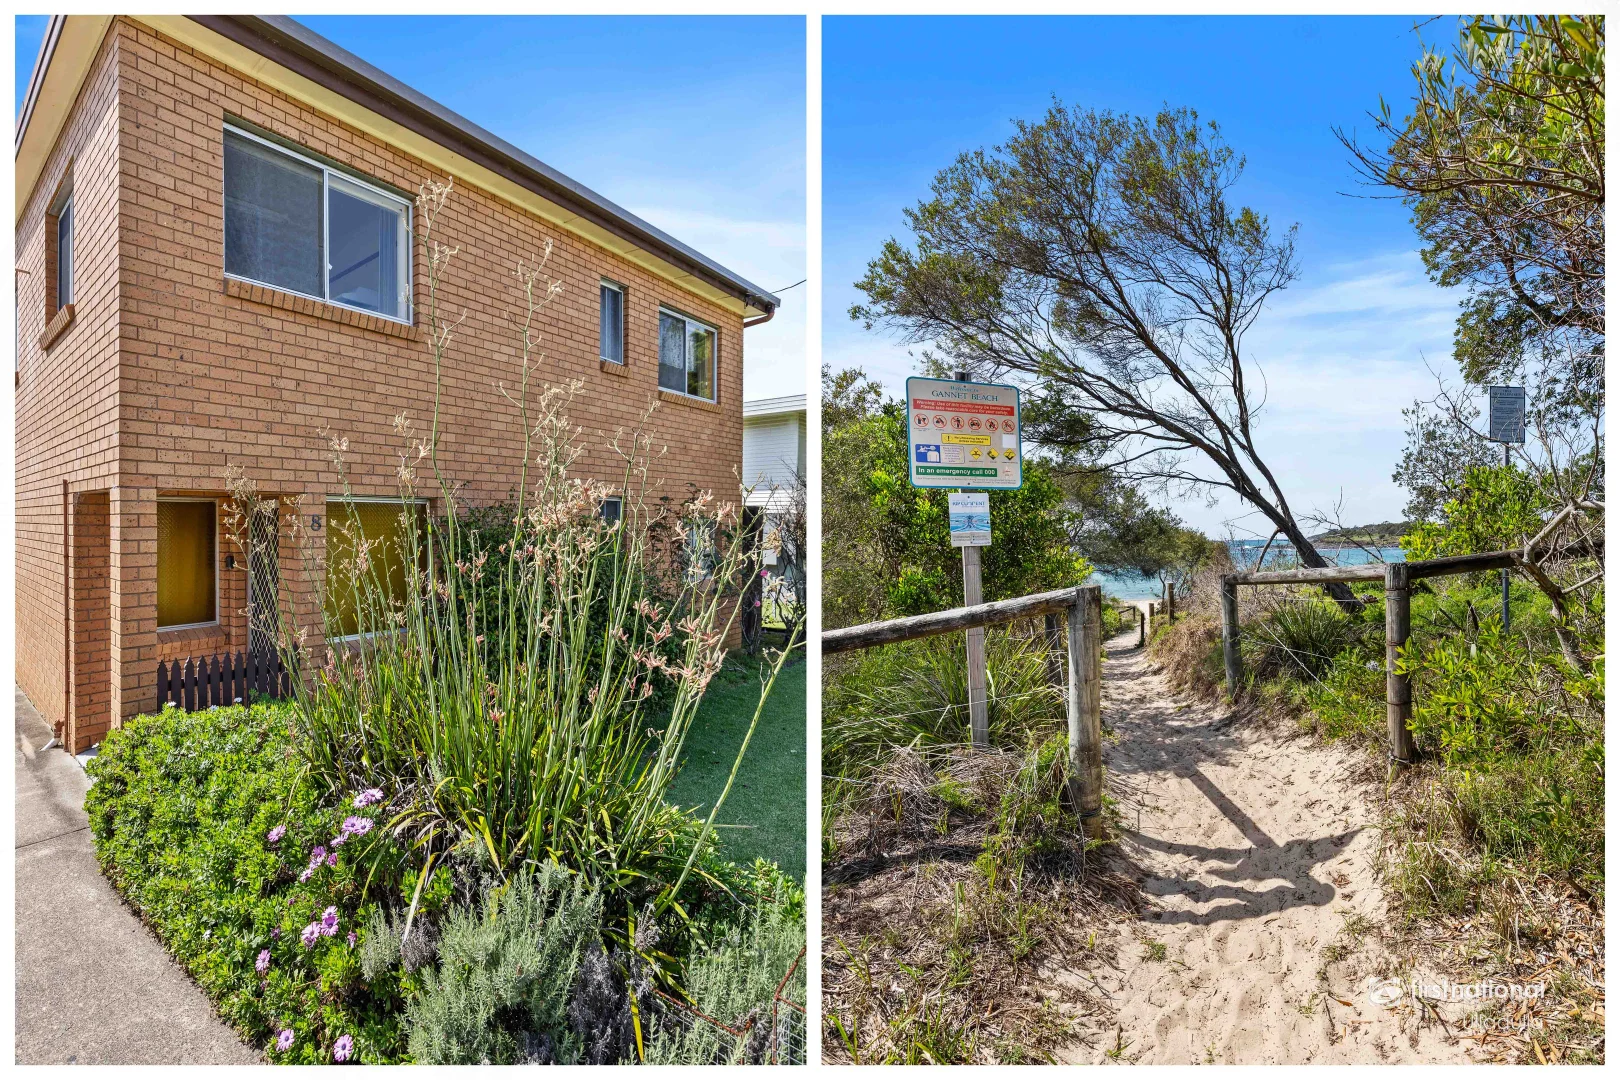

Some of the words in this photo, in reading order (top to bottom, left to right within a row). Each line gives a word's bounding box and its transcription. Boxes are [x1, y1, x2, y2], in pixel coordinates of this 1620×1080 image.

[932, 390, 968, 400] GANNET
[971, 394, 998, 402] BEACH
[310, 514, 321, 531] 8
